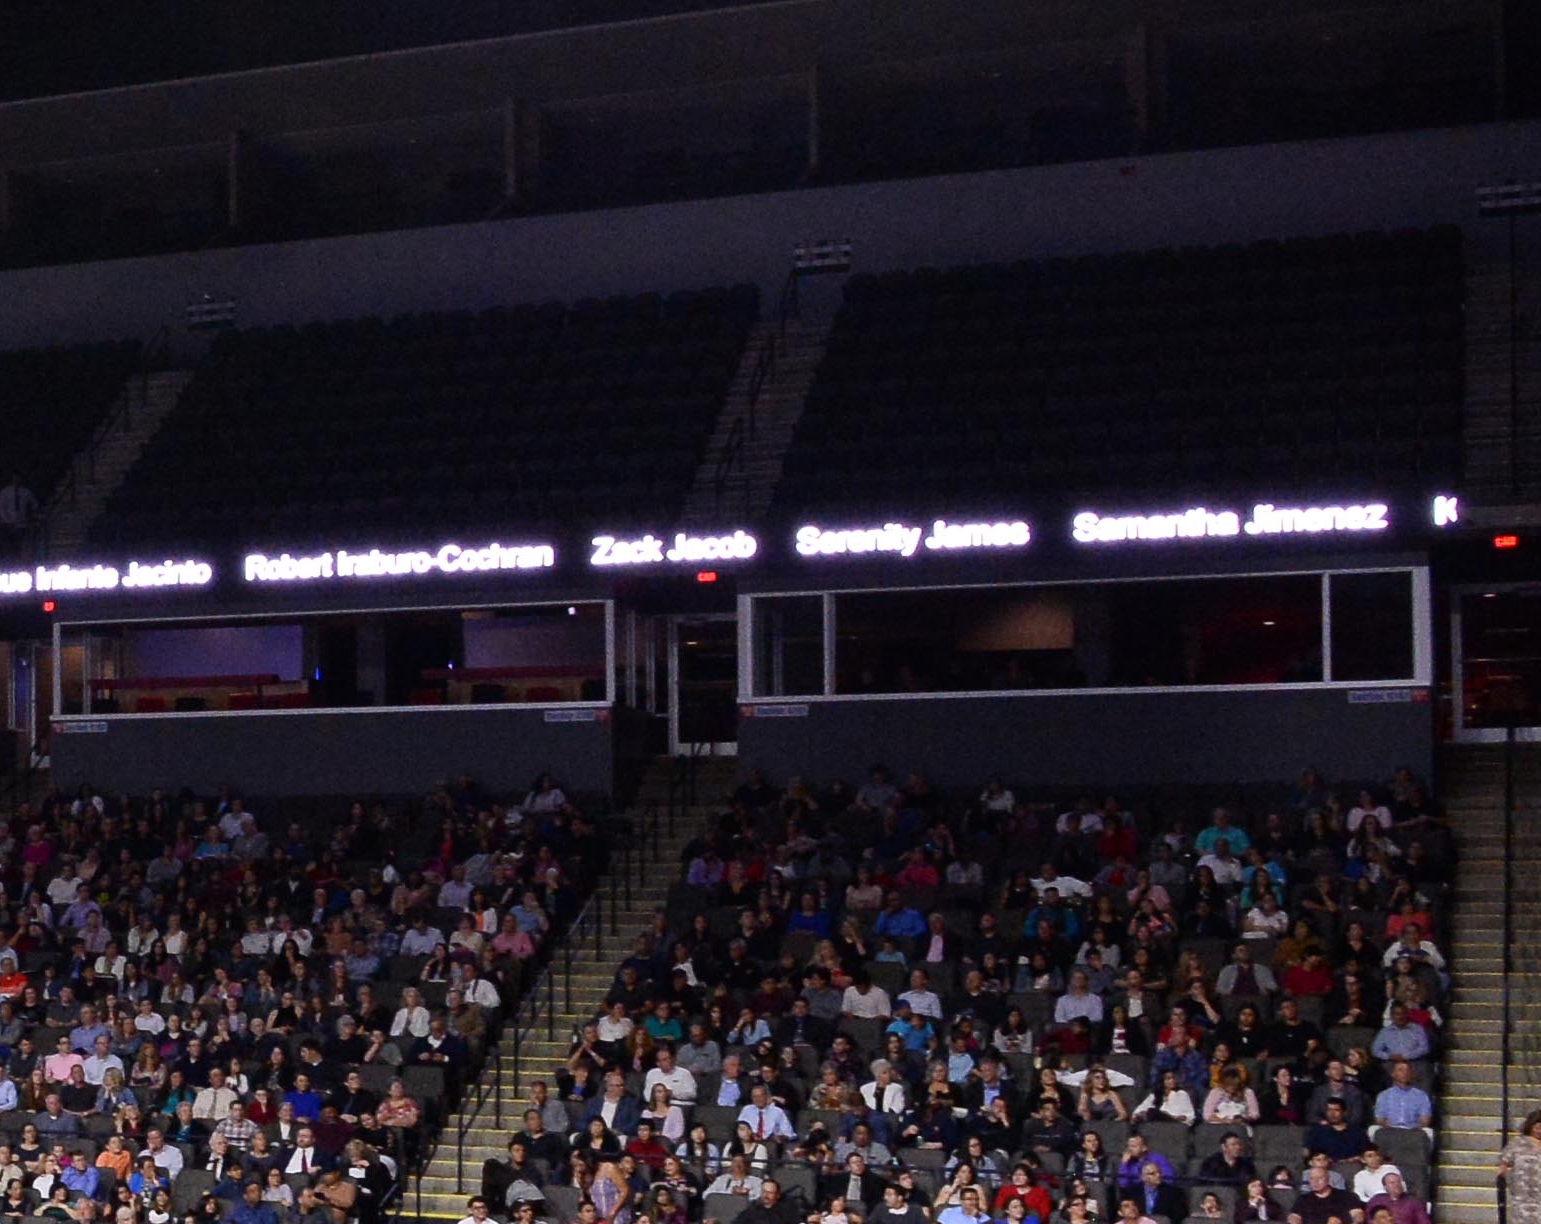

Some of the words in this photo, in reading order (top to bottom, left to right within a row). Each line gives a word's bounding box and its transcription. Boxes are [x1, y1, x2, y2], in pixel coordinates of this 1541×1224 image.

[795, 522, 922, 557] Serenity
[924, 519, 1031, 550] James
[1072, 508, 1240, 543] Samantha
[1243, 503, 1388, 535] Jimenez
[590, 534, 665, 566] Zack
[666, 530, 757, 562] Jacob
[35, 564, 120, 592] Infante
[121, 559, 213, 588] Jacinto
[244, 552, 334, 582] Robert
